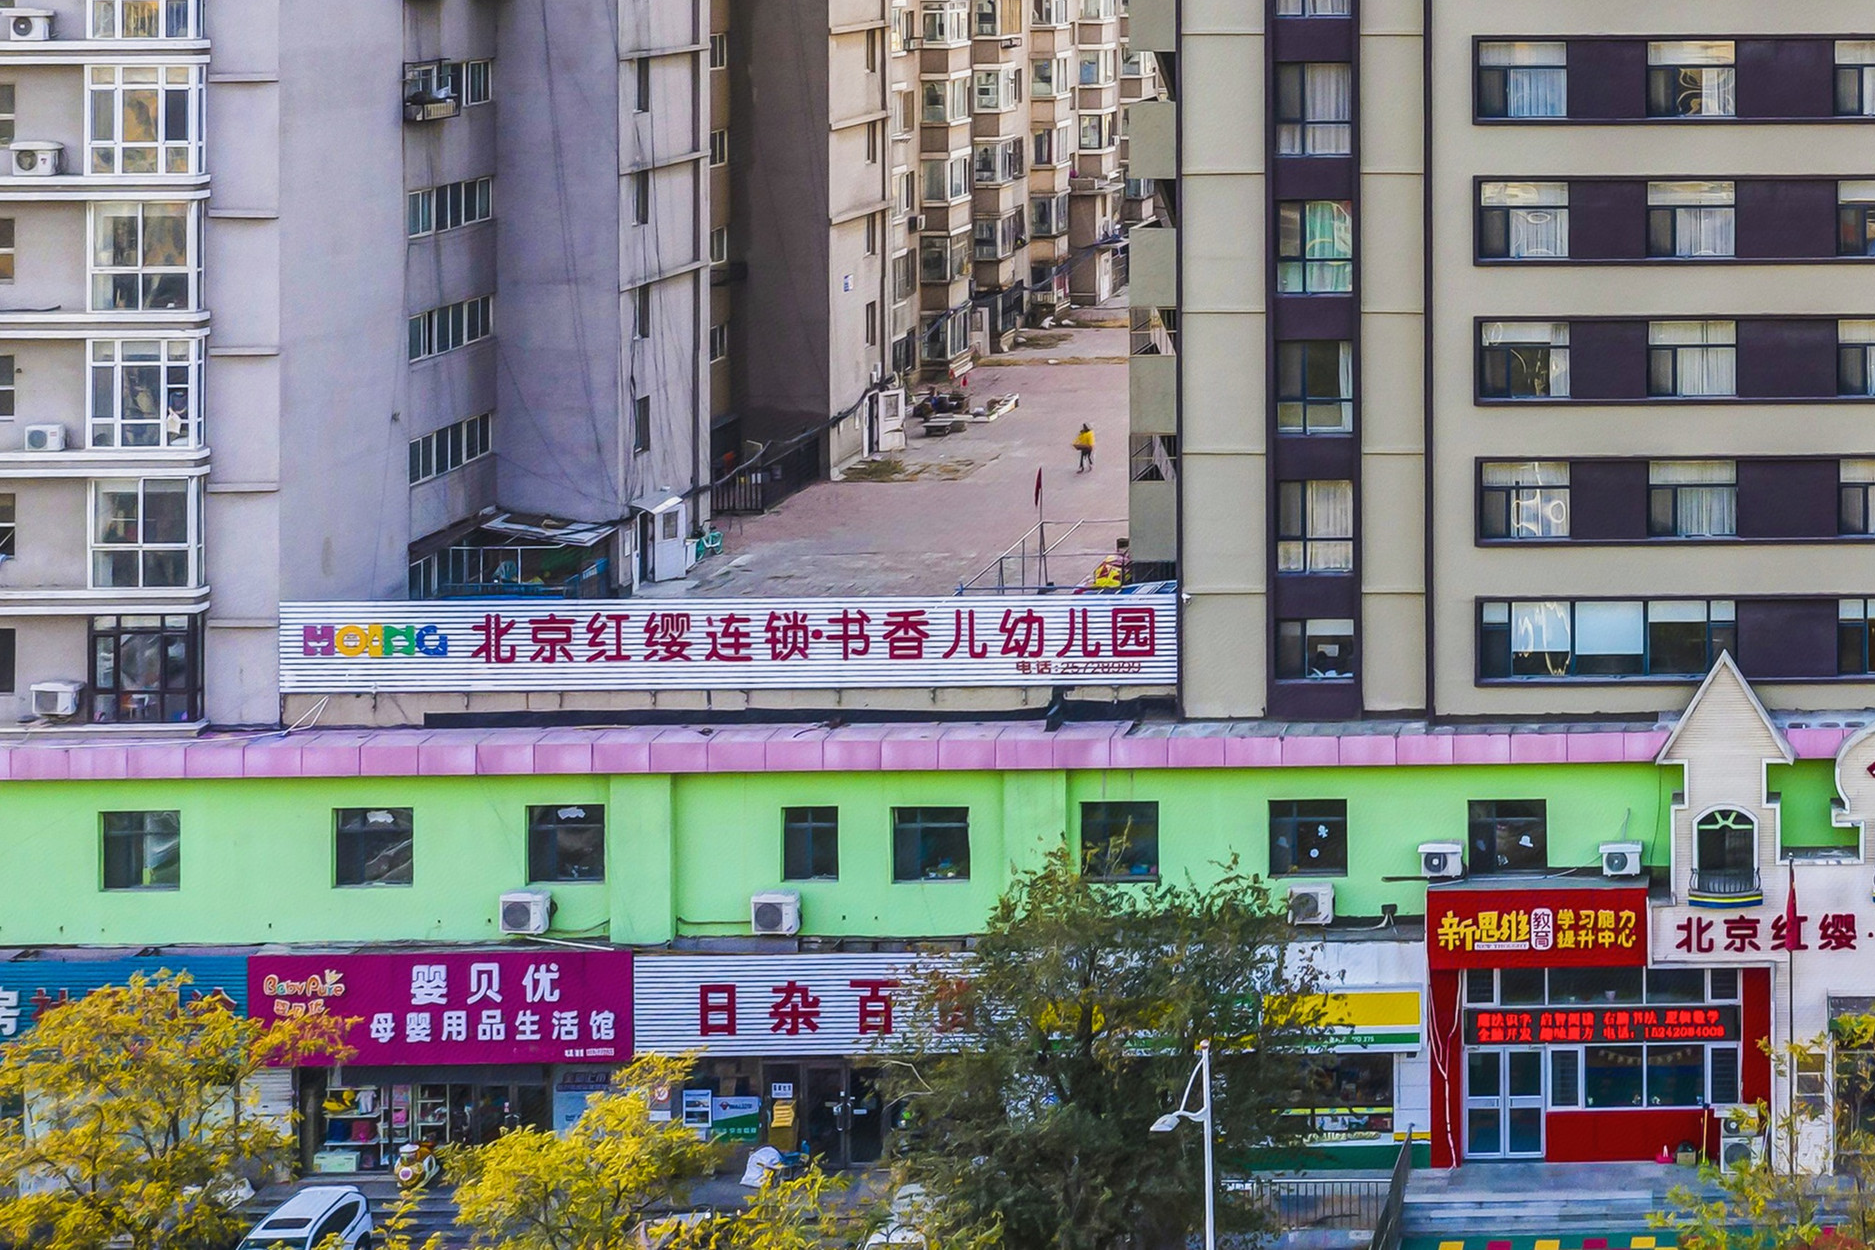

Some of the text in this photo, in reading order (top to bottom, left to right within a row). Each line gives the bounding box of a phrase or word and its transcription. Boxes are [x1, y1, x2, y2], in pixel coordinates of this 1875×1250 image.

[471, 607, 1156, 664] 北京红缨连锁·书香儿幼儿园
[1437, 910, 1530, 951] 新思维
[1533, 912, 1551, 948] 教育
[1557, 909, 1636, 928] 学习能力
[1556, 929, 1636, 949] 提升中心
[410, 962, 560, 1005] 婴贝优
[370, 1009, 615, 1043] 母婴用品生活馆
